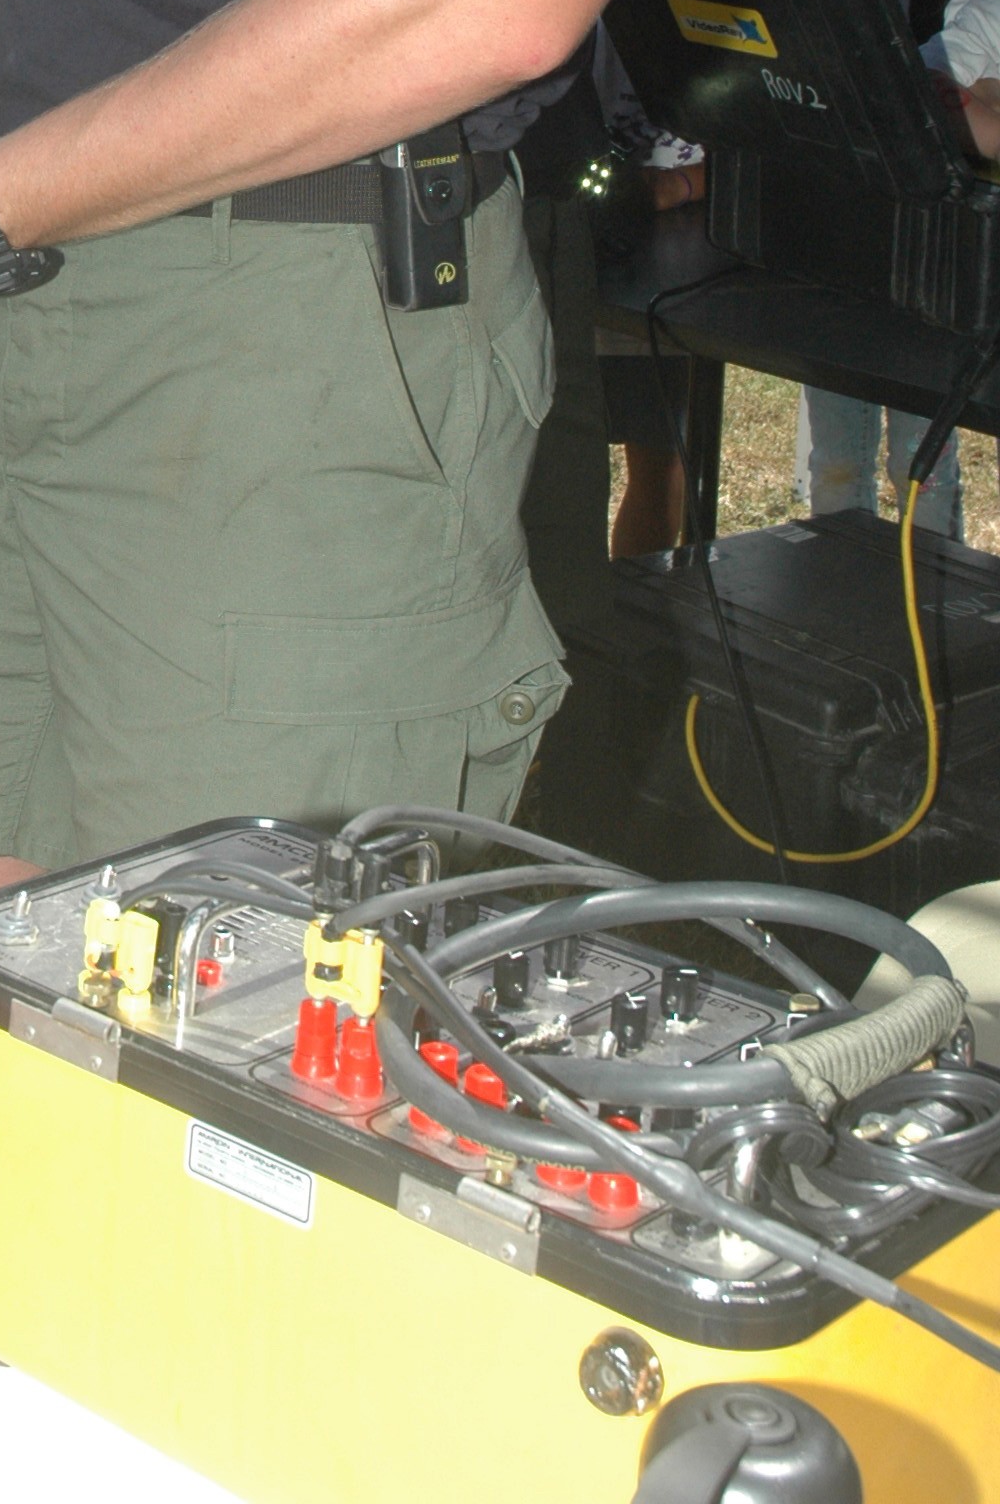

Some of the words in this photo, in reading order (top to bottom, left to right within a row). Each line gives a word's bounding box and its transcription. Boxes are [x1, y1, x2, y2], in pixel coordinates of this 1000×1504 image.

[761, 68, 803, 105] ROV
[806, 85, 828, 110] 2
[578, 951, 622, 972] VER
